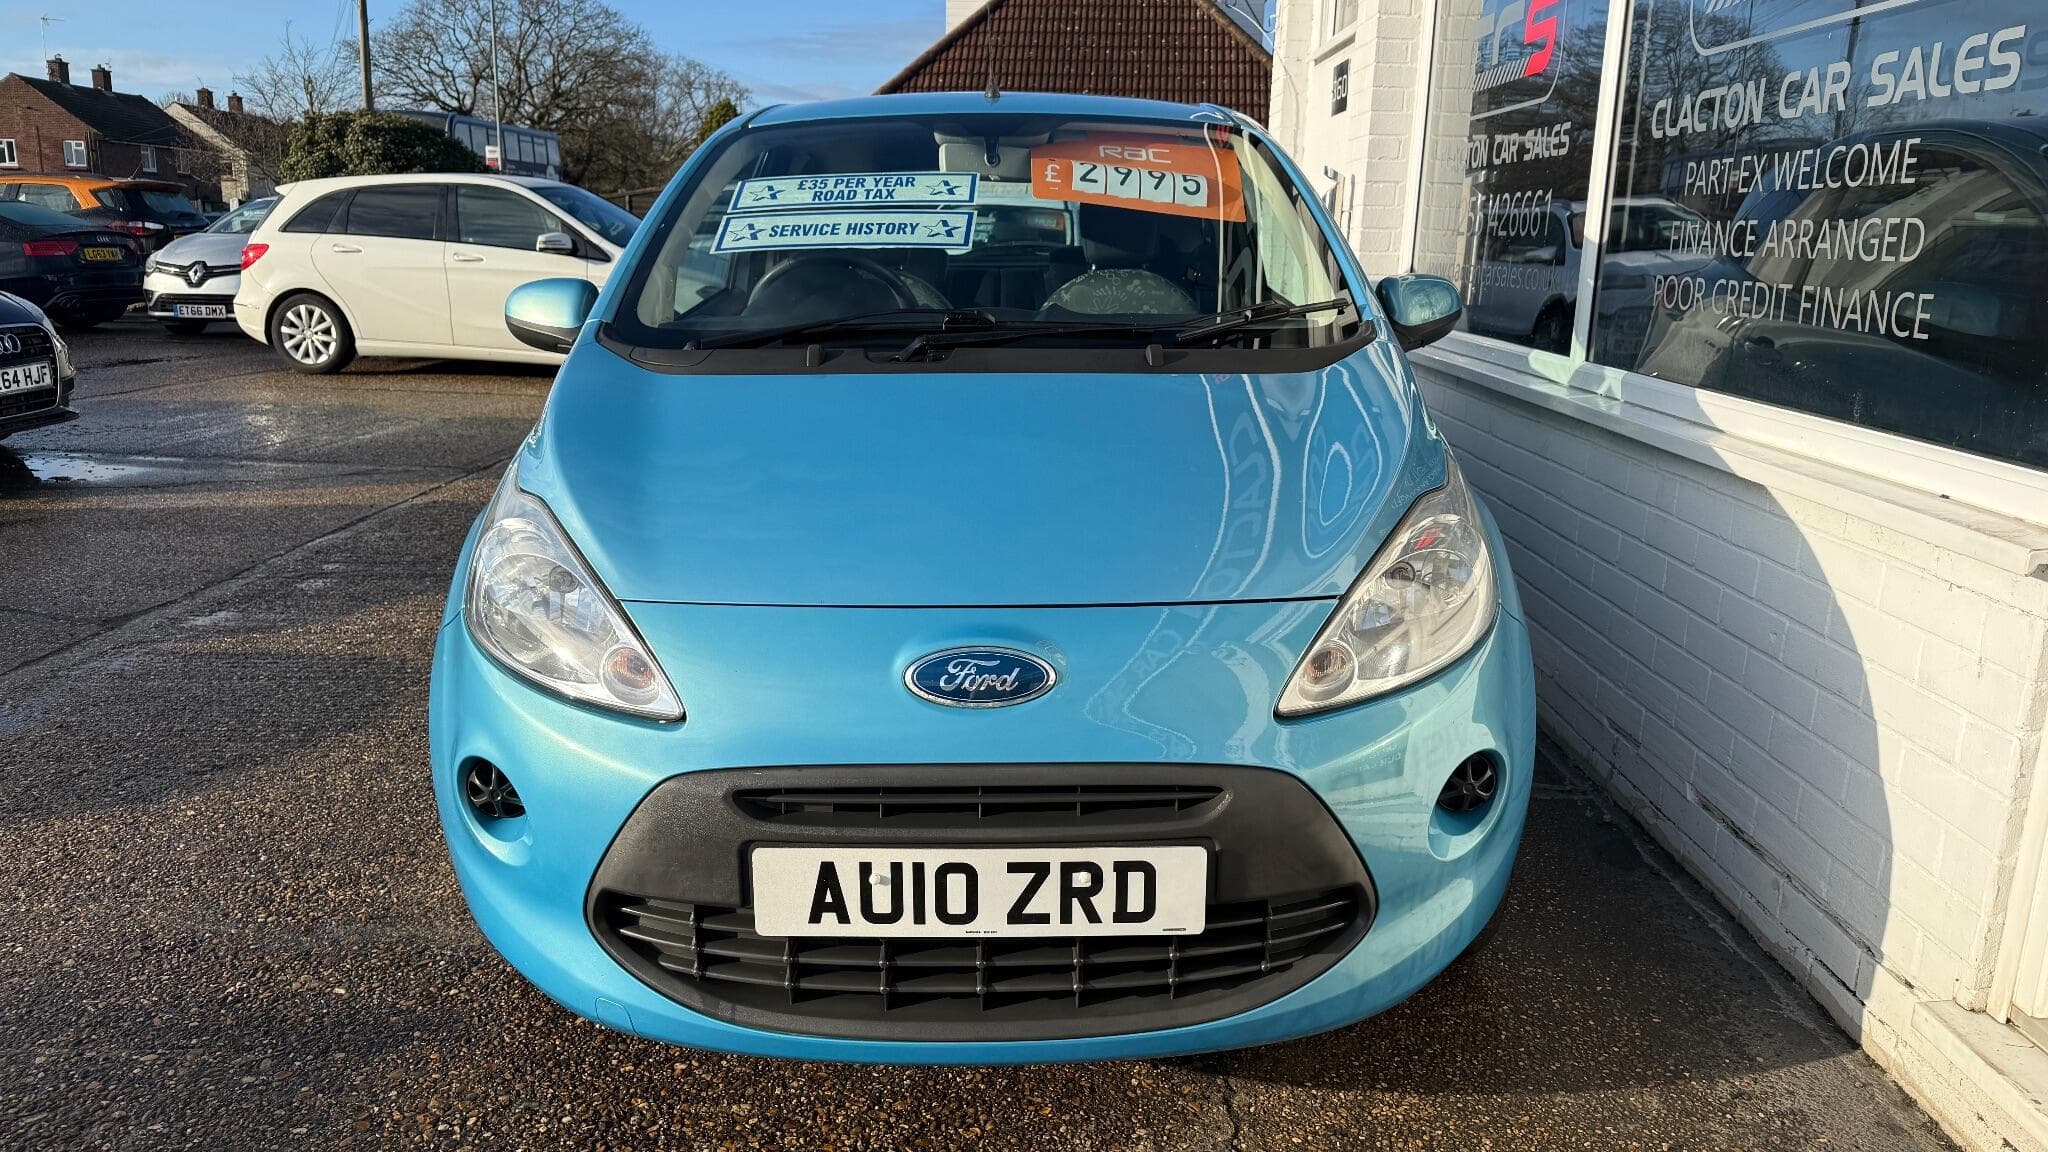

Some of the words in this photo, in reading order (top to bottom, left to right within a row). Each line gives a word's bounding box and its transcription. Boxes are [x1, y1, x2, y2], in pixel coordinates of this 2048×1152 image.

[1651, 77, 1767, 139] CLACTON
[1778, 60, 1852, 119] CAR
[1866, 24, 2028, 109] SALES
[1493, 133, 1519, 165] CAR
[1523, 121, 1572, 161] SALES
[1774, 137, 1922, 192] WELCOME
[797, 179, 829, 191] £35
[834, 177, 867, 190] PER
[873, 176, 916, 188] YEAR
[811, 189, 858, 202] ROAD
[864, 188, 896, 200] TAX
[768, 222, 842, 238] SERVICE
[846, 222, 921, 237] HISTORY
[1488, 188, 1553, 238] 426661
[1669, 219, 1759, 258] FINANCE
[1761, 217, 1926, 263] ARRANGED
[179, 305, 203, 317] ET66
[205, 306, 225, 317] DMX
[1652, 274, 1706, 313] POOR
[1711, 278, 1794, 323] CREDIT
[1798, 284, 1936, 340] FINANCE
[0, 369, 21, 390] 64
[22, 365, 48, 387] HJF
[939, 658, 1021, 692] Ford
[1005, 859, 1158, 926] ZRD
